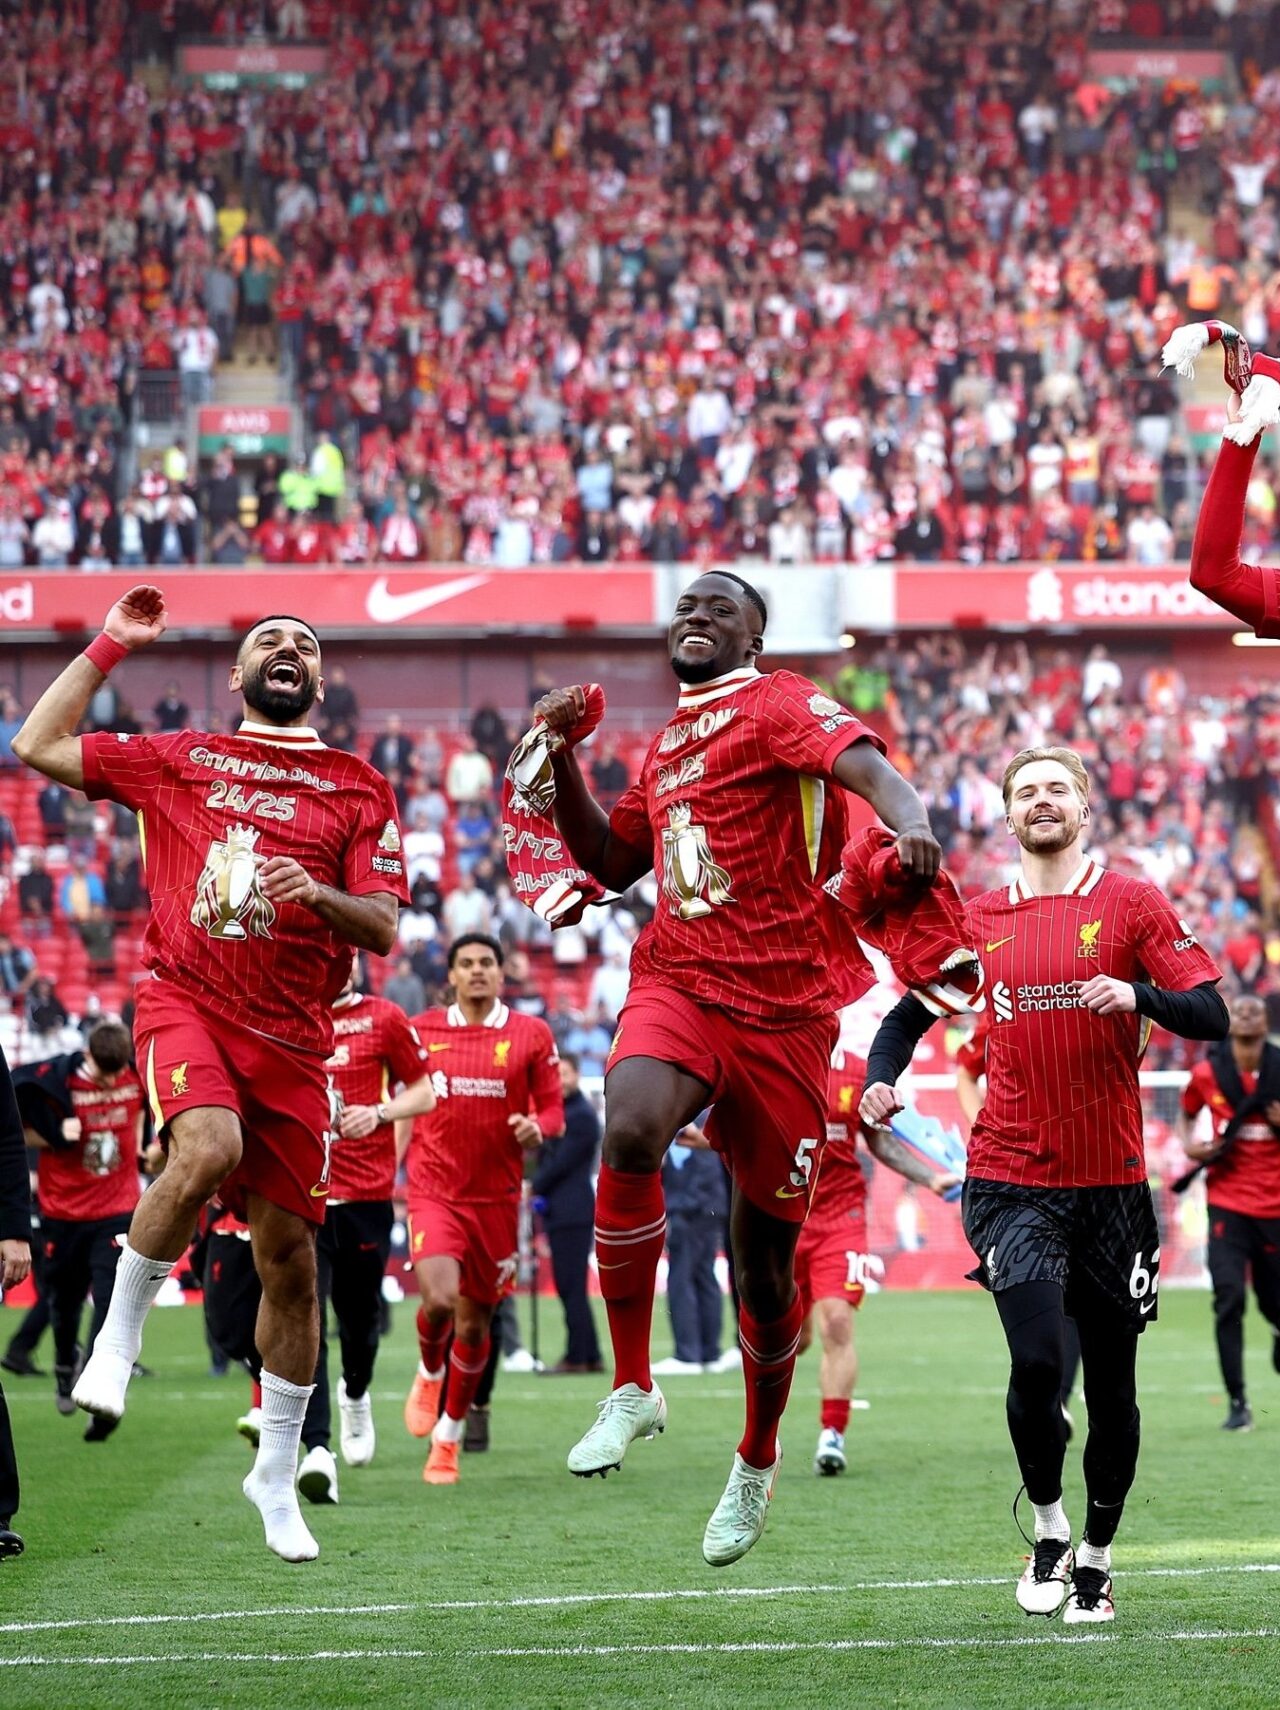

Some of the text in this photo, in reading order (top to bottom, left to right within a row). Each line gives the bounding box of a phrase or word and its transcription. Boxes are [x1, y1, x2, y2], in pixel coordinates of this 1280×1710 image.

[189, 746, 338, 792] CHAMPIONS
[206, 779, 297, 821] 24/25
[1017, 981, 1078, 998] standa
[1018, 996, 1087, 1012] chartere
[789, 1138, 818, 1187] 5
